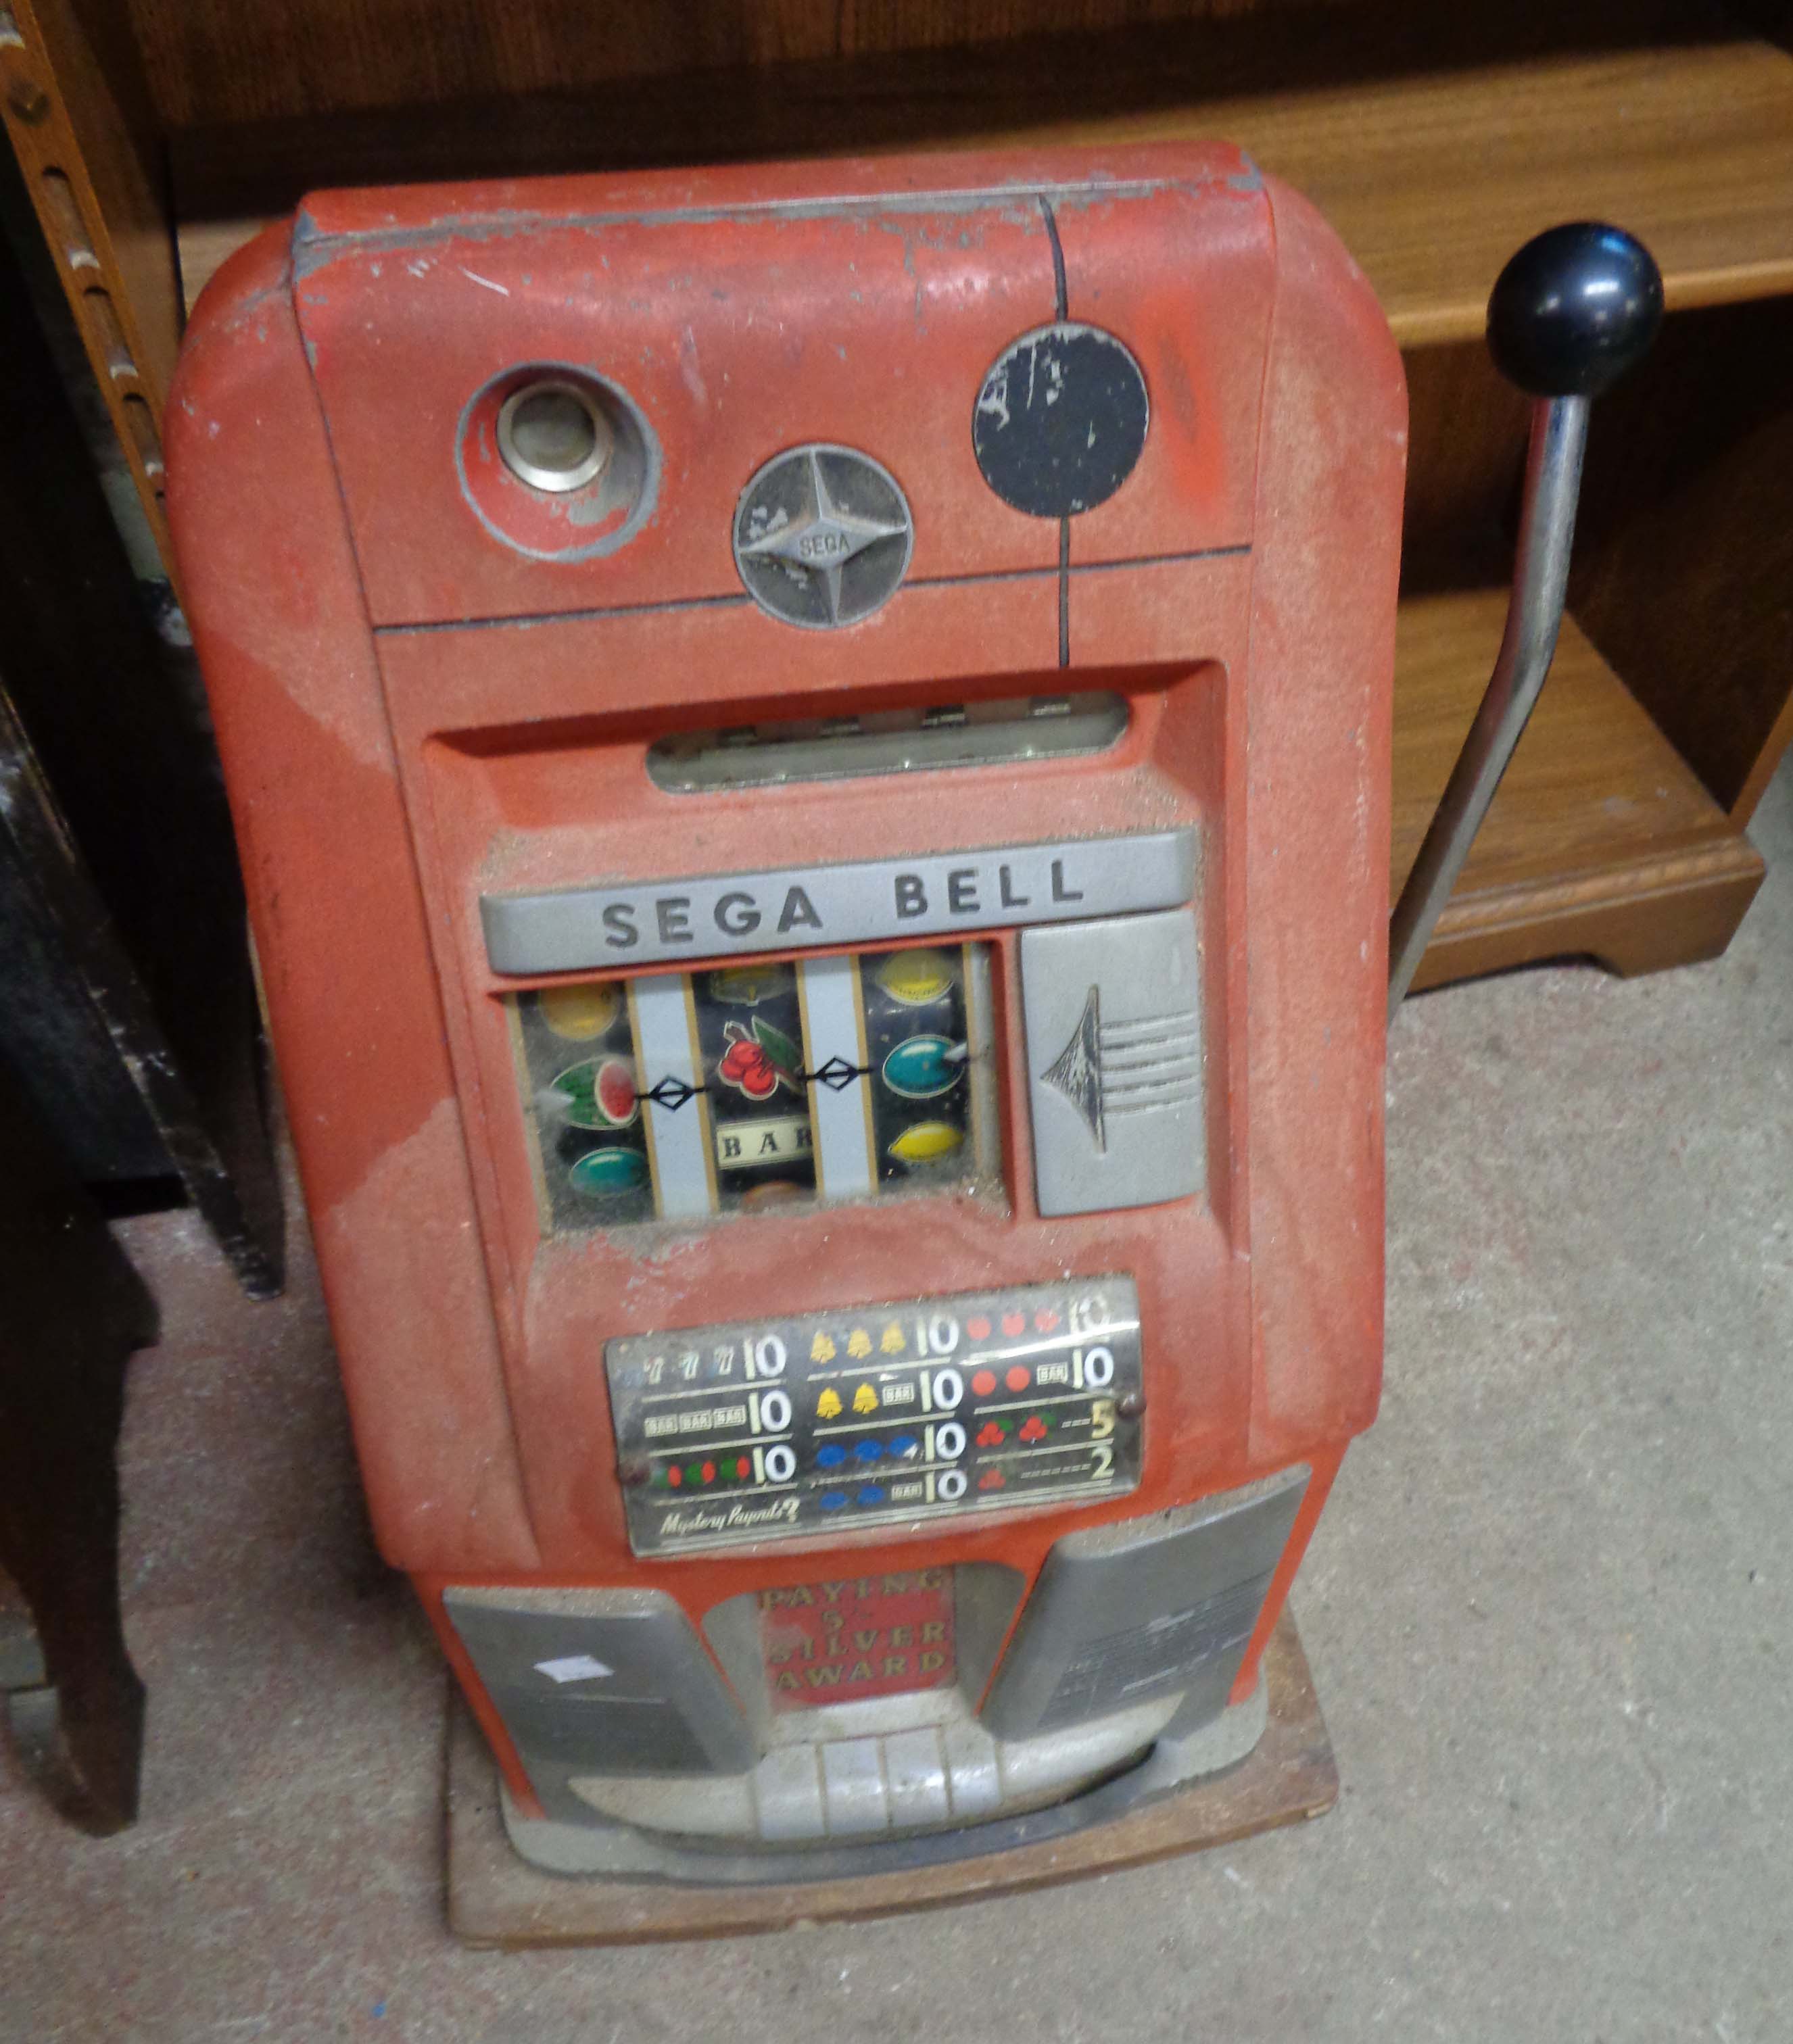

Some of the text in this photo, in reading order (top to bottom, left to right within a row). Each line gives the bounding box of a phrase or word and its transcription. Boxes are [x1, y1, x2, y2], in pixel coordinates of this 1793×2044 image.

[800, 533, 851, 557] SEGA
[601, 859, 1084, 948] SEGA BELL
[723, 1125, 812, 1159] BAR
[1069, 1295, 1109, 1335] 10
[916, 1315, 959, 1357] 10
[744, 1334, 786, 1380] 10
[1038, 1346, 1114, 1389] BAR 10
[884, 1369, 963, 1412] BAR 10
[715, 1407, 744, 1426] BAR
[748, 1390, 792, 1434] 10
[1091, 1400, 1115, 1438] 5
[925, 1422, 966, 1461] 10
[753, 1444, 796, 1484] 10
[1091, 1446, 1115, 1480] 2
[892, 1469, 967, 1503] BAR 10
[660, 1511, 726, 1536] Mystery
[759, 1568, 942, 1610] PAYING
[775, 1650, 946, 1690] AWARD
